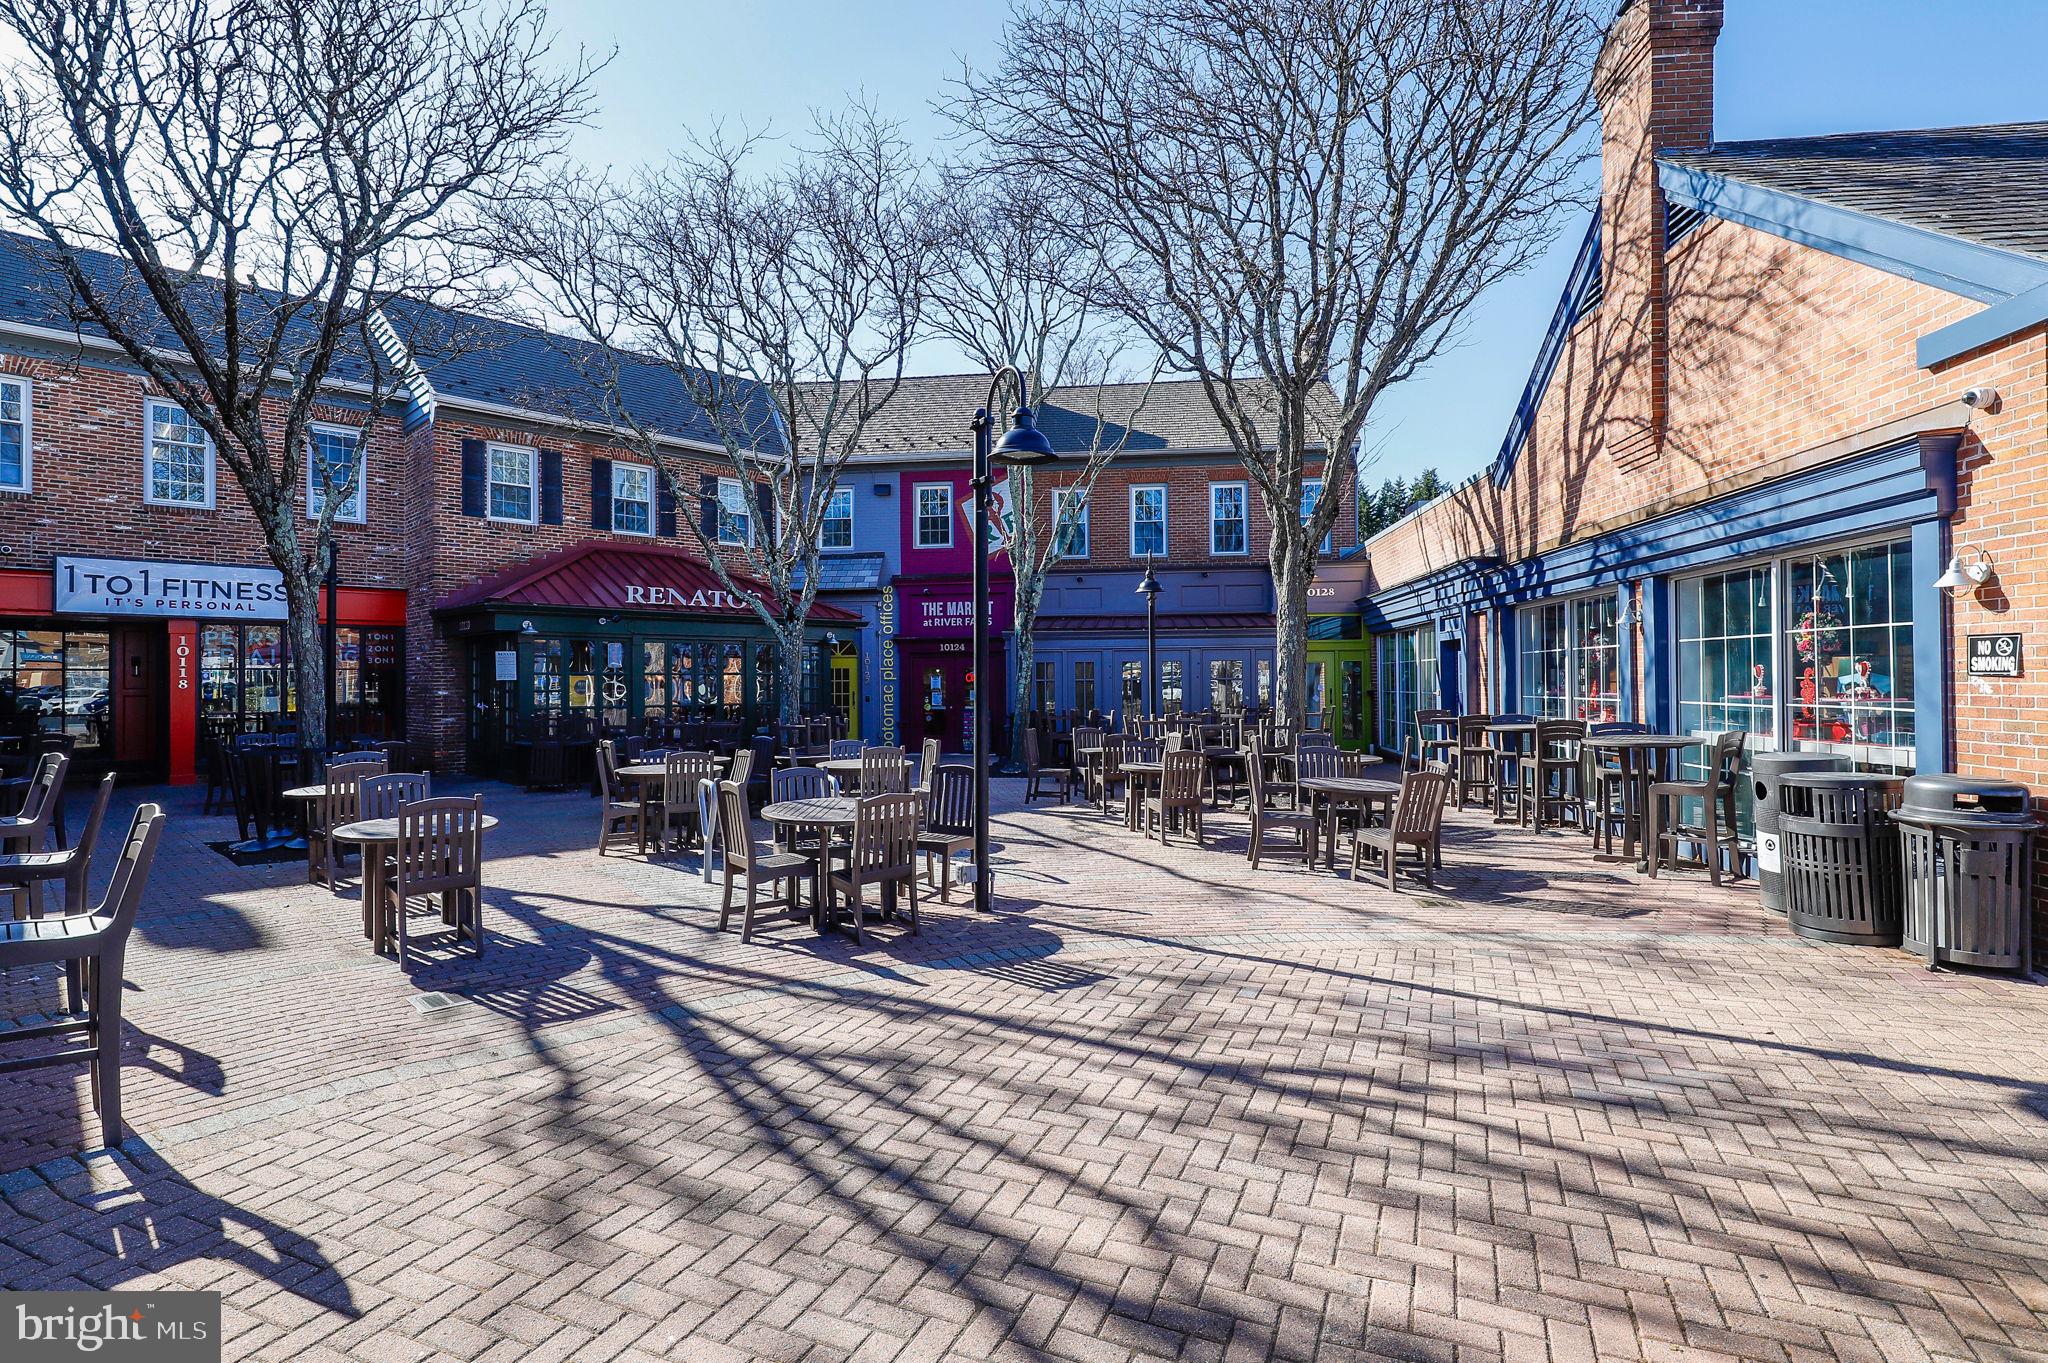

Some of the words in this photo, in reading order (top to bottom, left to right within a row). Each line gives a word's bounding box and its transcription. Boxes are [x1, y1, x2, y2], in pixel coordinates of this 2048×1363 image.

[64, 565, 75, 592] 1
[84, 574, 133, 595] TO
[139, 569, 149, 595] 1
[162, 578, 287, 601] FITNESS
[1307, 588, 1335, 597] 0128
[105, 597, 144, 608] IT'S
[156, 599, 256, 612] PERSONAL
[880, 585, 893, 634] offices
[922, 602, 943, 616] THE
[947, 601, 993, 616] MART
[934, 618, 962, 627] RIVER
[965, 618, 993, 627] FAS
[940, 643, 965, 651] 10124
[1977, 640, 1992, 655] NO
[176, 635, 190, 689] 10118
[880, 640, 896, 680] place
[1971, 656, 2016, 671] SMOKING
